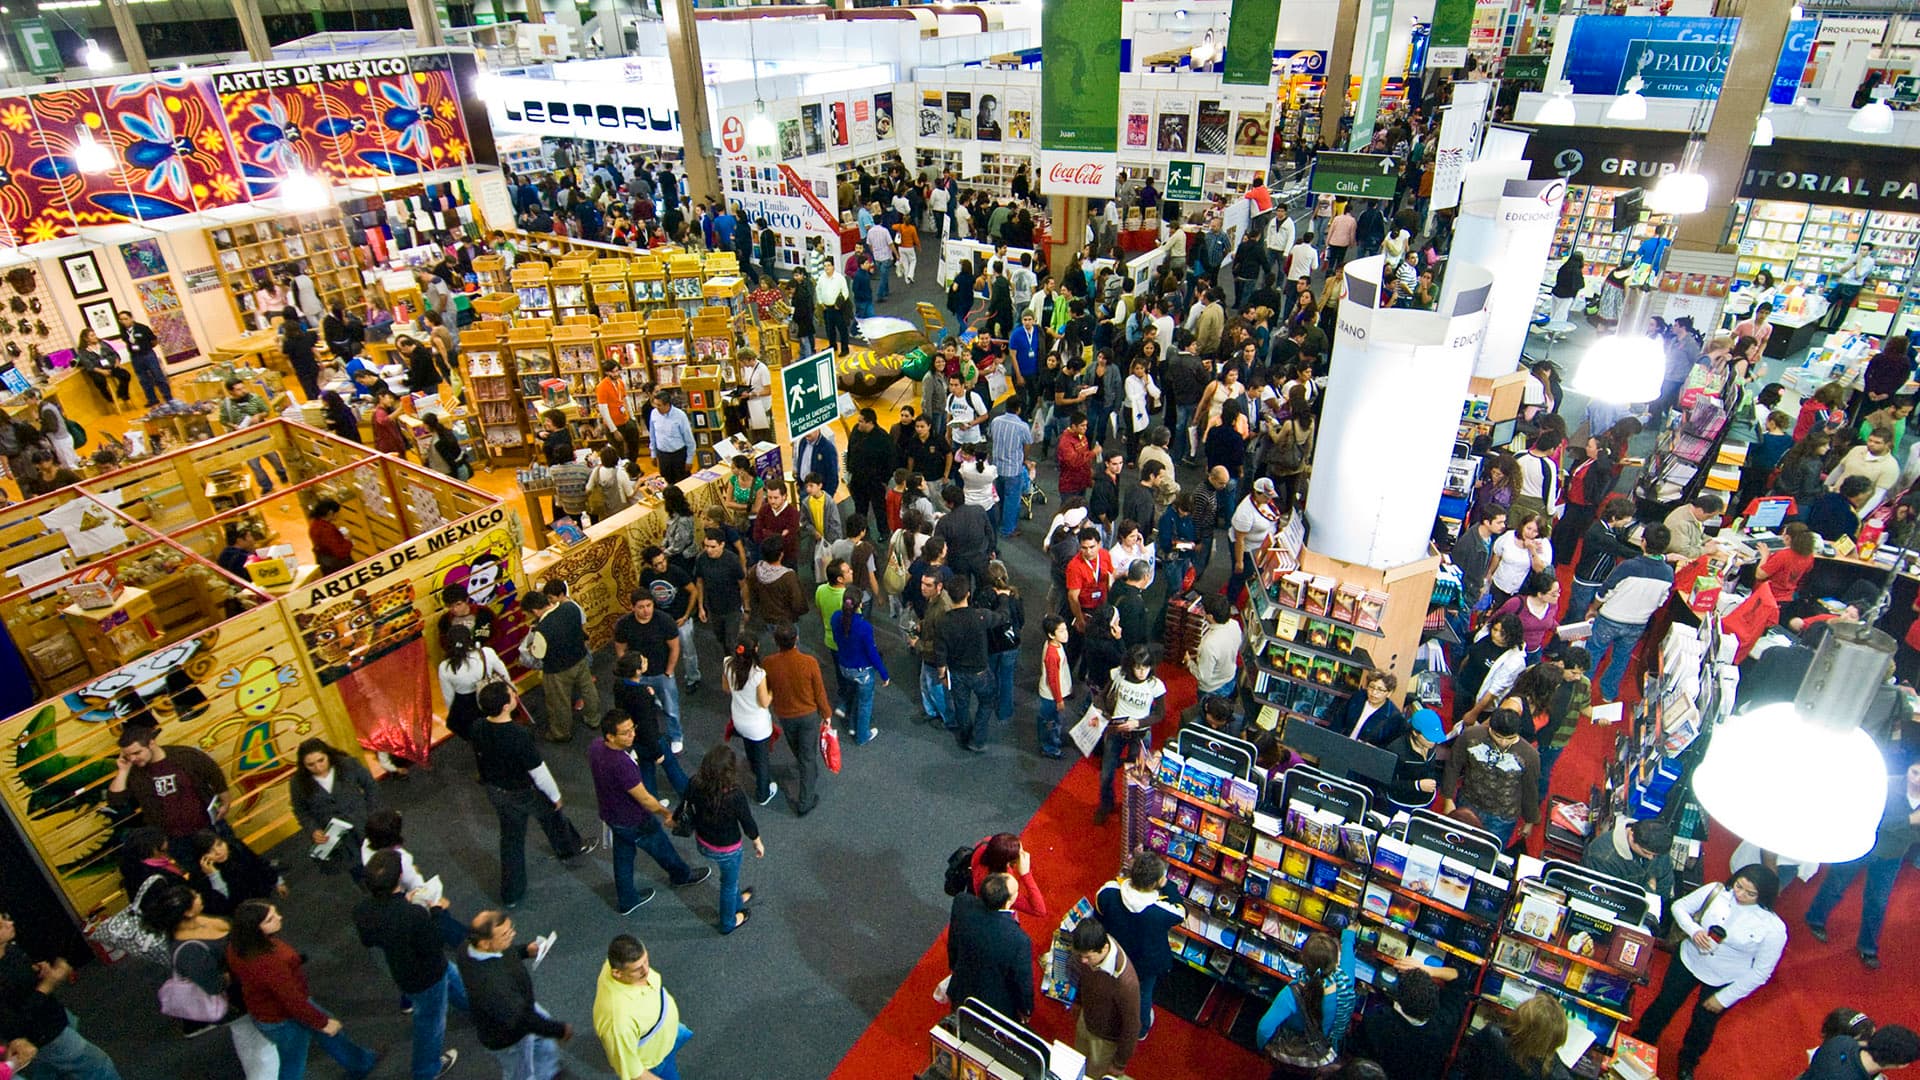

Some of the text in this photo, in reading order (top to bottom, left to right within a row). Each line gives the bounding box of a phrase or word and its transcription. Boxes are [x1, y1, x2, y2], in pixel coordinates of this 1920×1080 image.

[21, 26, 50, 67] F
[218, 57, 407, 92] ARTES DE MEXICO
[1357, 15, 1387, 125] F
[1336, 178, 1371, 192] Calle F
[309, 508, 504, 607] ARTES DE MÉXICO
[1422, 834, 1480, 859] EDICIONES URANO
[1562, 885, 1626, 911] EDICIONES URANO
